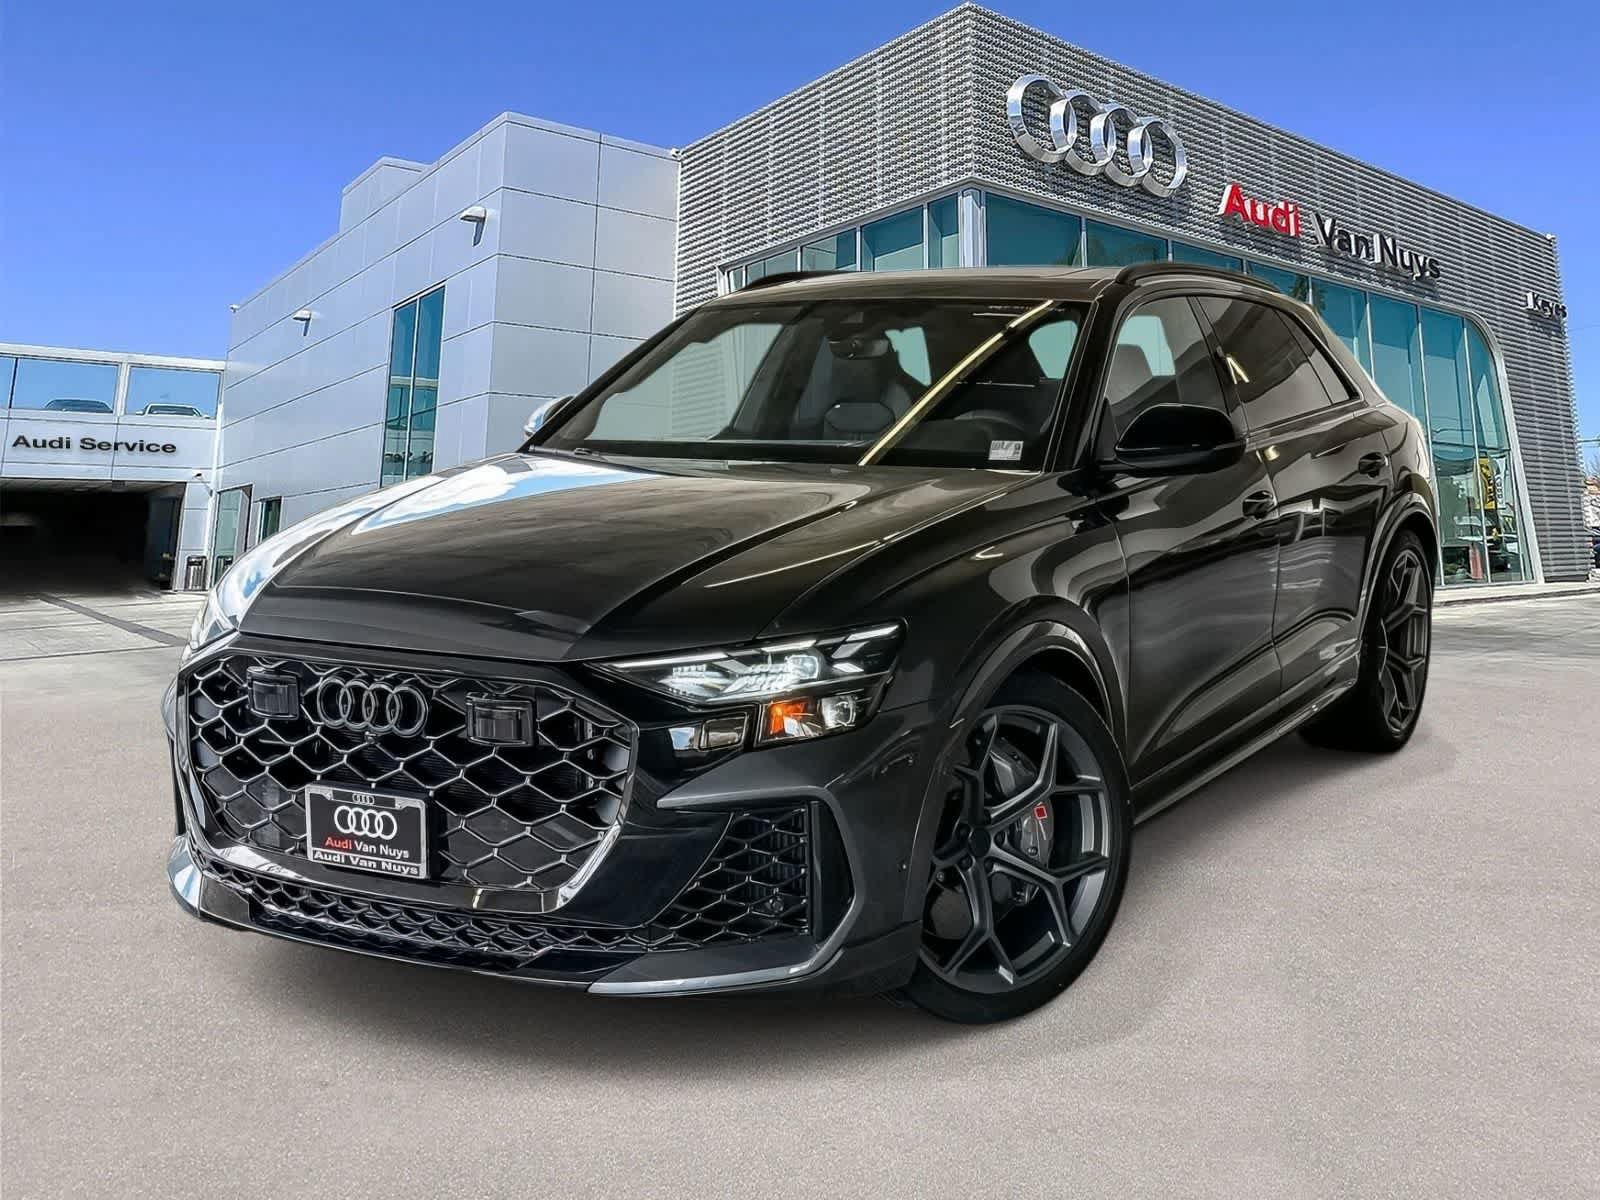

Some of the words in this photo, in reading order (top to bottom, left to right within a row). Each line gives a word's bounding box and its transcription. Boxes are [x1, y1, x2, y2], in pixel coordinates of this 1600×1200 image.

[1219, 183, 1301, 238] Audi
[1311, 213, 1371, 259] Van
[1374, 233, 1440, 280] Nuys
[12, 435, 71, 449] Audi
[80, 437, 177, 454] Service
[325, 837, 352, 850] Audi
[354, 840, 377, 854] Van
[379, 844, 409, 860] Nuys
[313, 851, 345, 863] Audi
[350, 856, 377, 868] Van
[381, 862, 418, 875] Nuys
